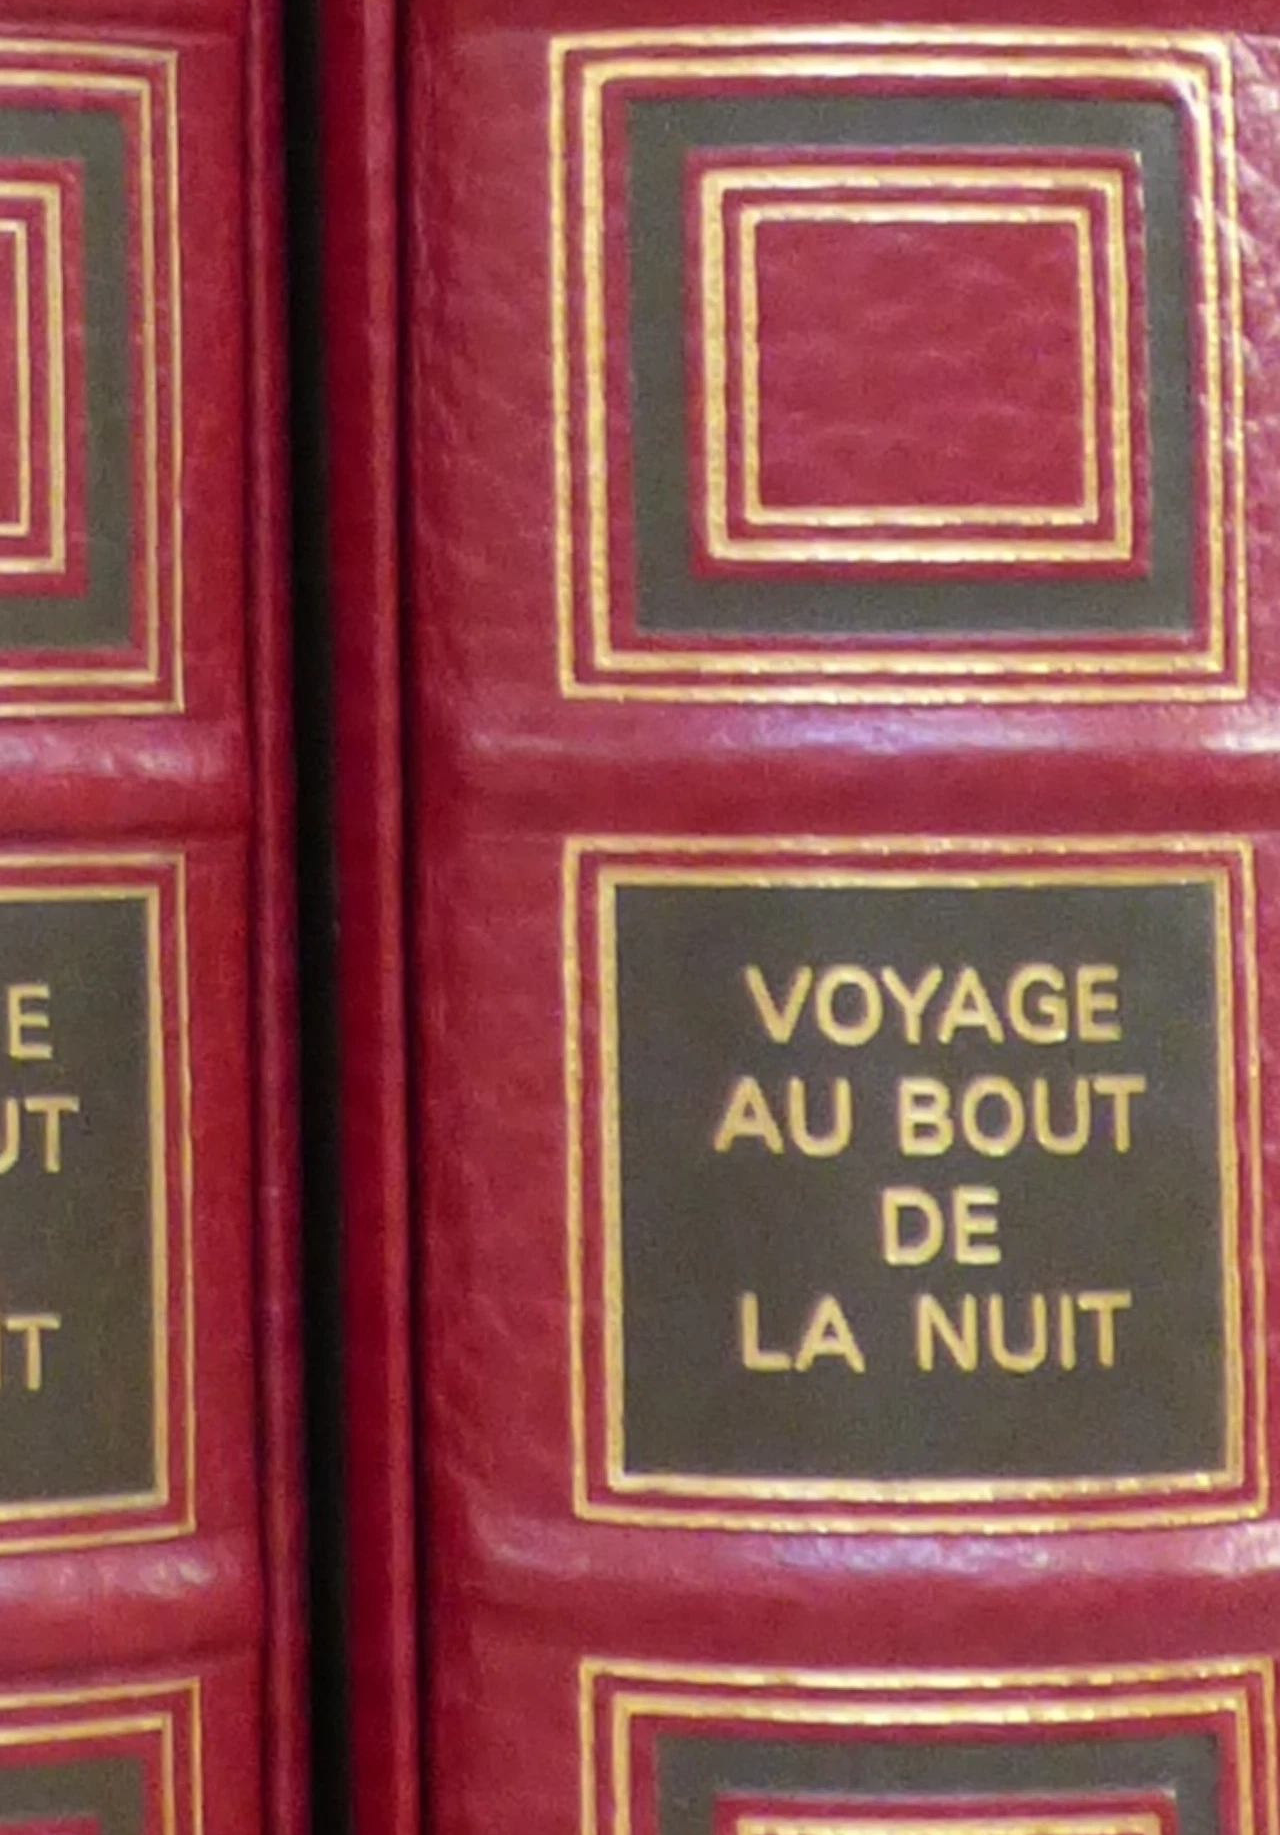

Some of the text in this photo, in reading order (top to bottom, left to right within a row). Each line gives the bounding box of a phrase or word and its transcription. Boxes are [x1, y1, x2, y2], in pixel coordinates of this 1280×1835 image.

[745, 962, 1122, 1047] VOYAGE
[713, 1074, 1147, 1158] AU BOUT
[881, 1185, 1002, 1267] DE
[740, 1290, 1132, 1374] LA NUIT
